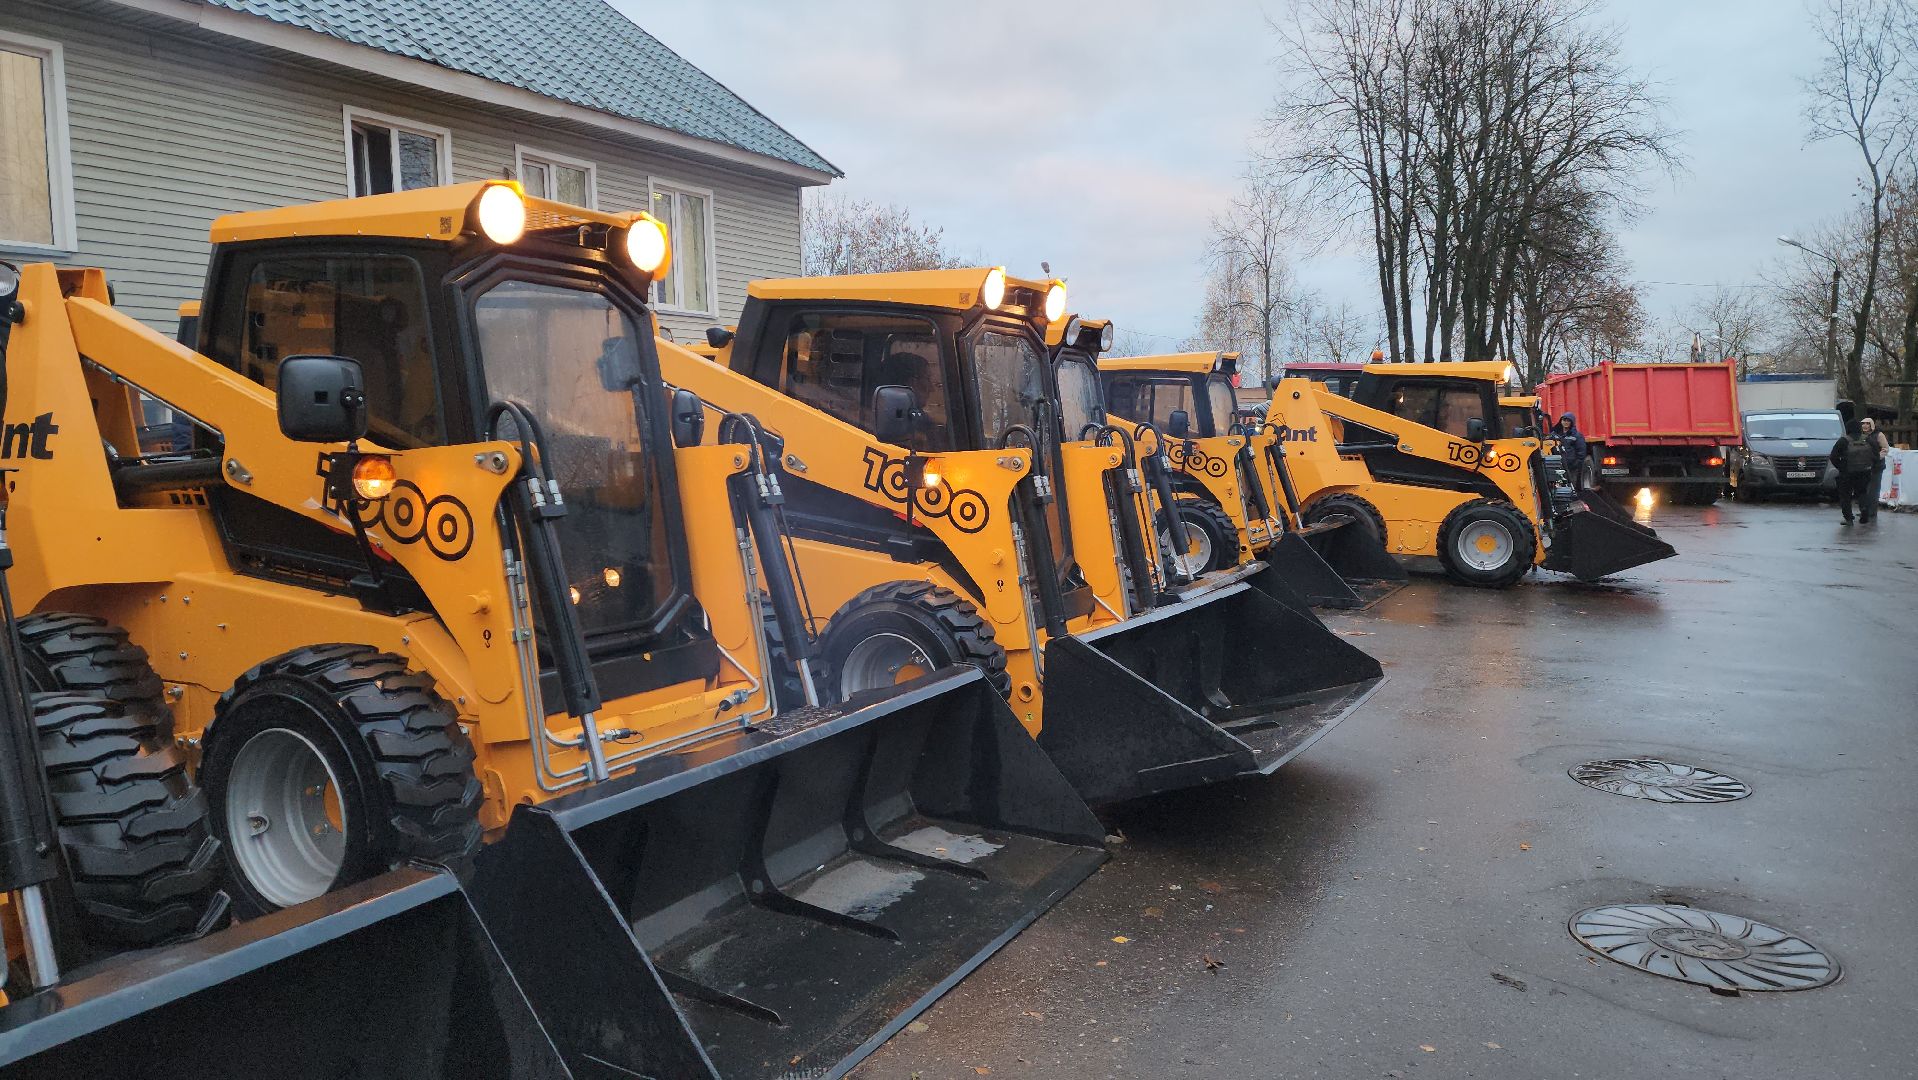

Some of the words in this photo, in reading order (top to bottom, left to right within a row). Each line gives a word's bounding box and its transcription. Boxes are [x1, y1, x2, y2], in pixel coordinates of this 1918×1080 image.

[0, 411, 59, 460] nt
[1448, 441, 1521, 472] 1000
[863, 445, 990, 534] 1000
